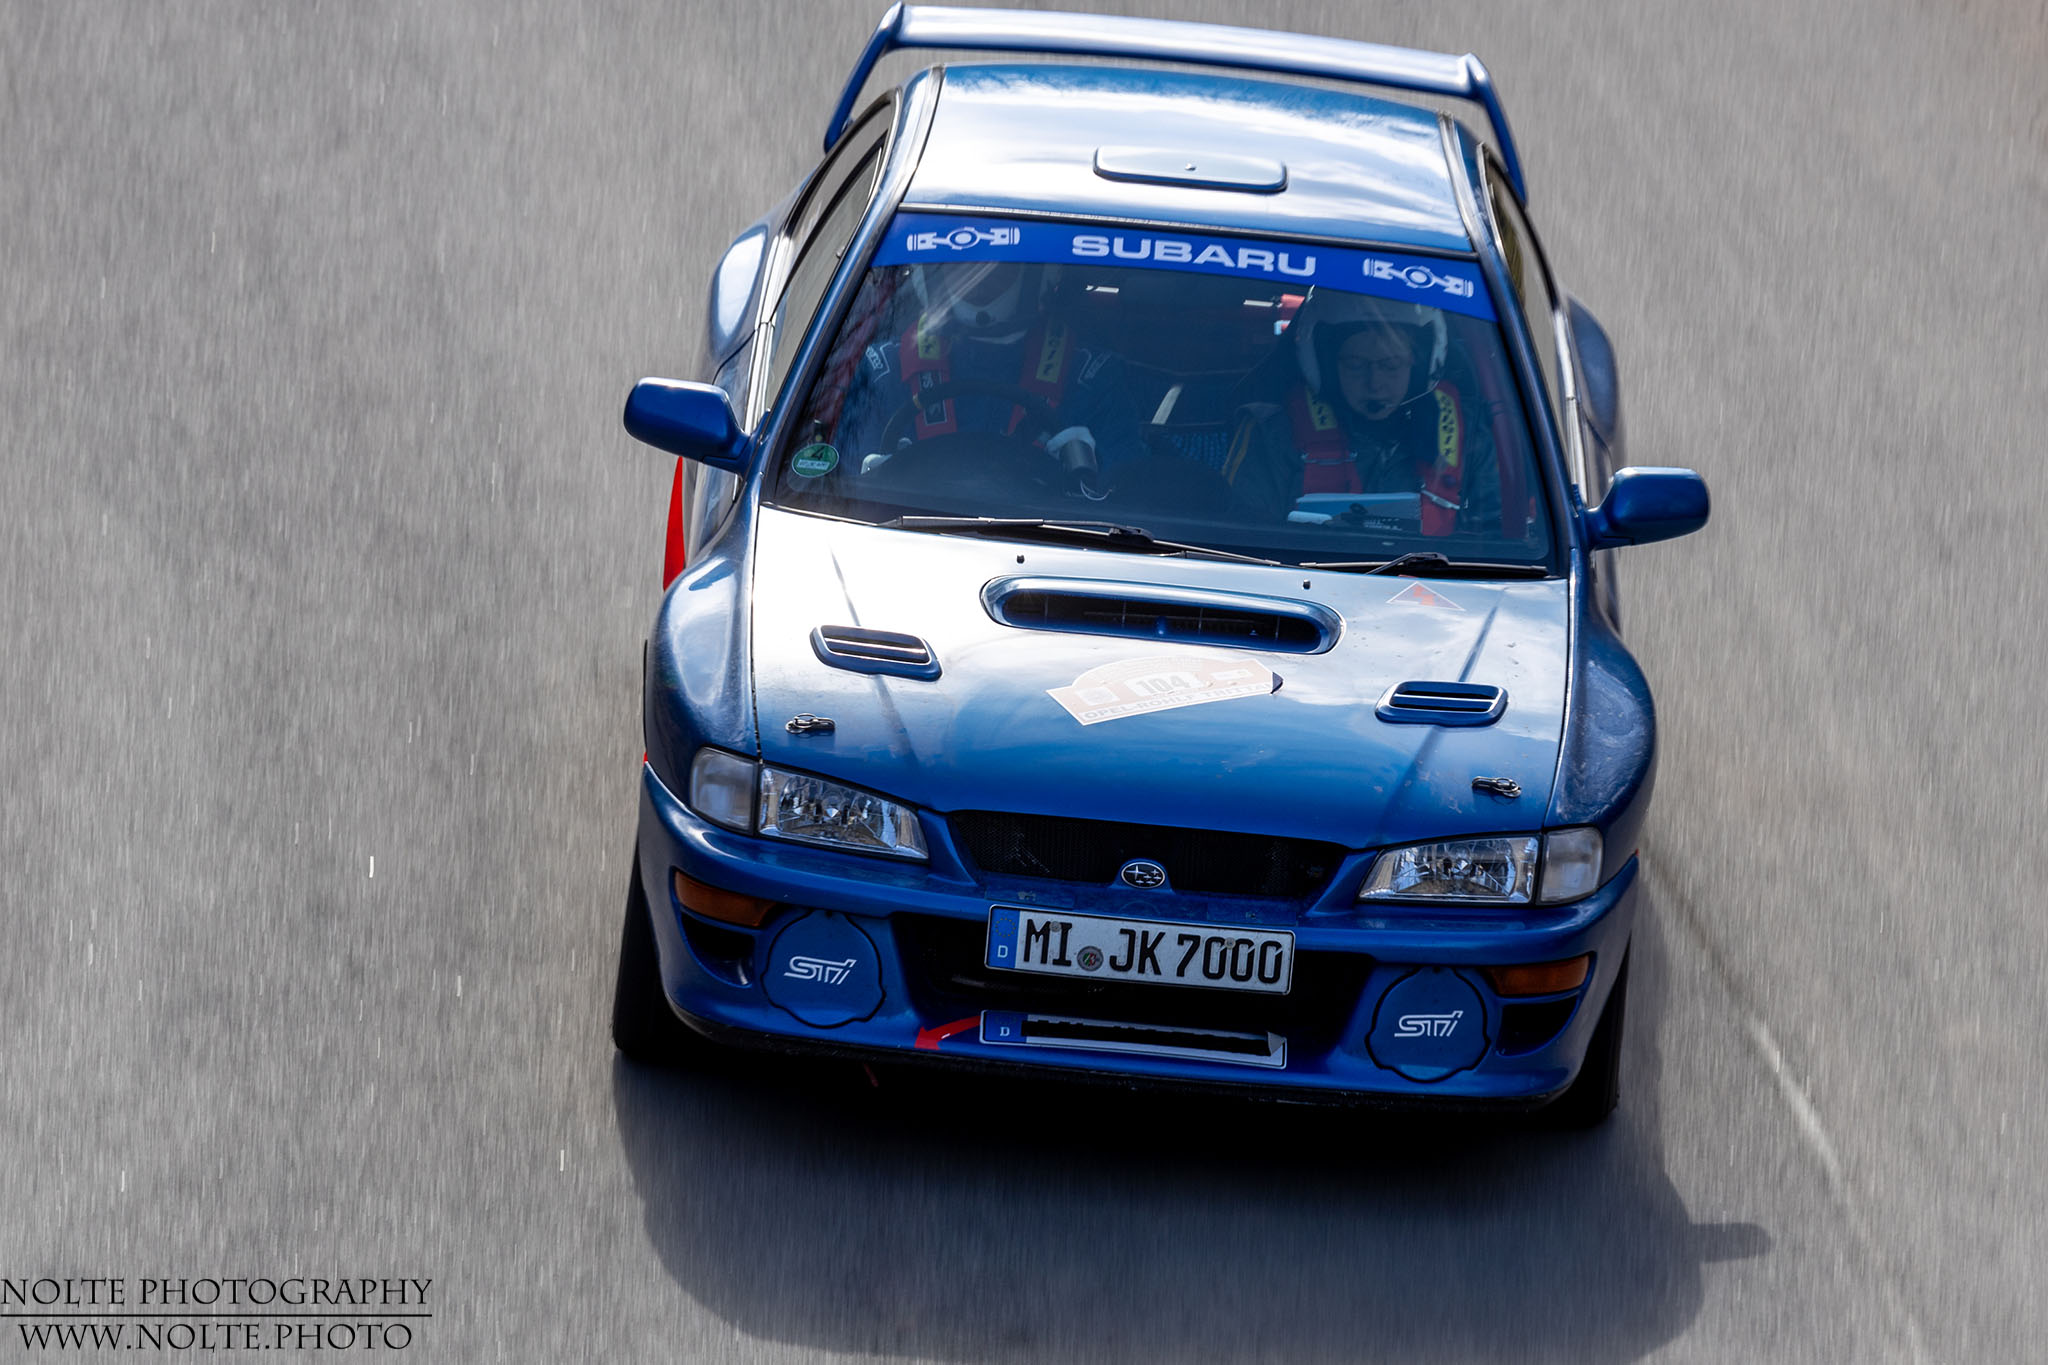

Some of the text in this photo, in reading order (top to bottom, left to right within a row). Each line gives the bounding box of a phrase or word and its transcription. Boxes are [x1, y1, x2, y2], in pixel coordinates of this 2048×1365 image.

[1072, 235, 1316, 277] SUBARU
[811, 446, 825, 460] 4
[1135, 675, 1192, 693] 104
[997, 945, 1008, 958] D
[1023, 918, 1283, 984] MI JK 7000
[1000, 1026, 1010, 1036] D
